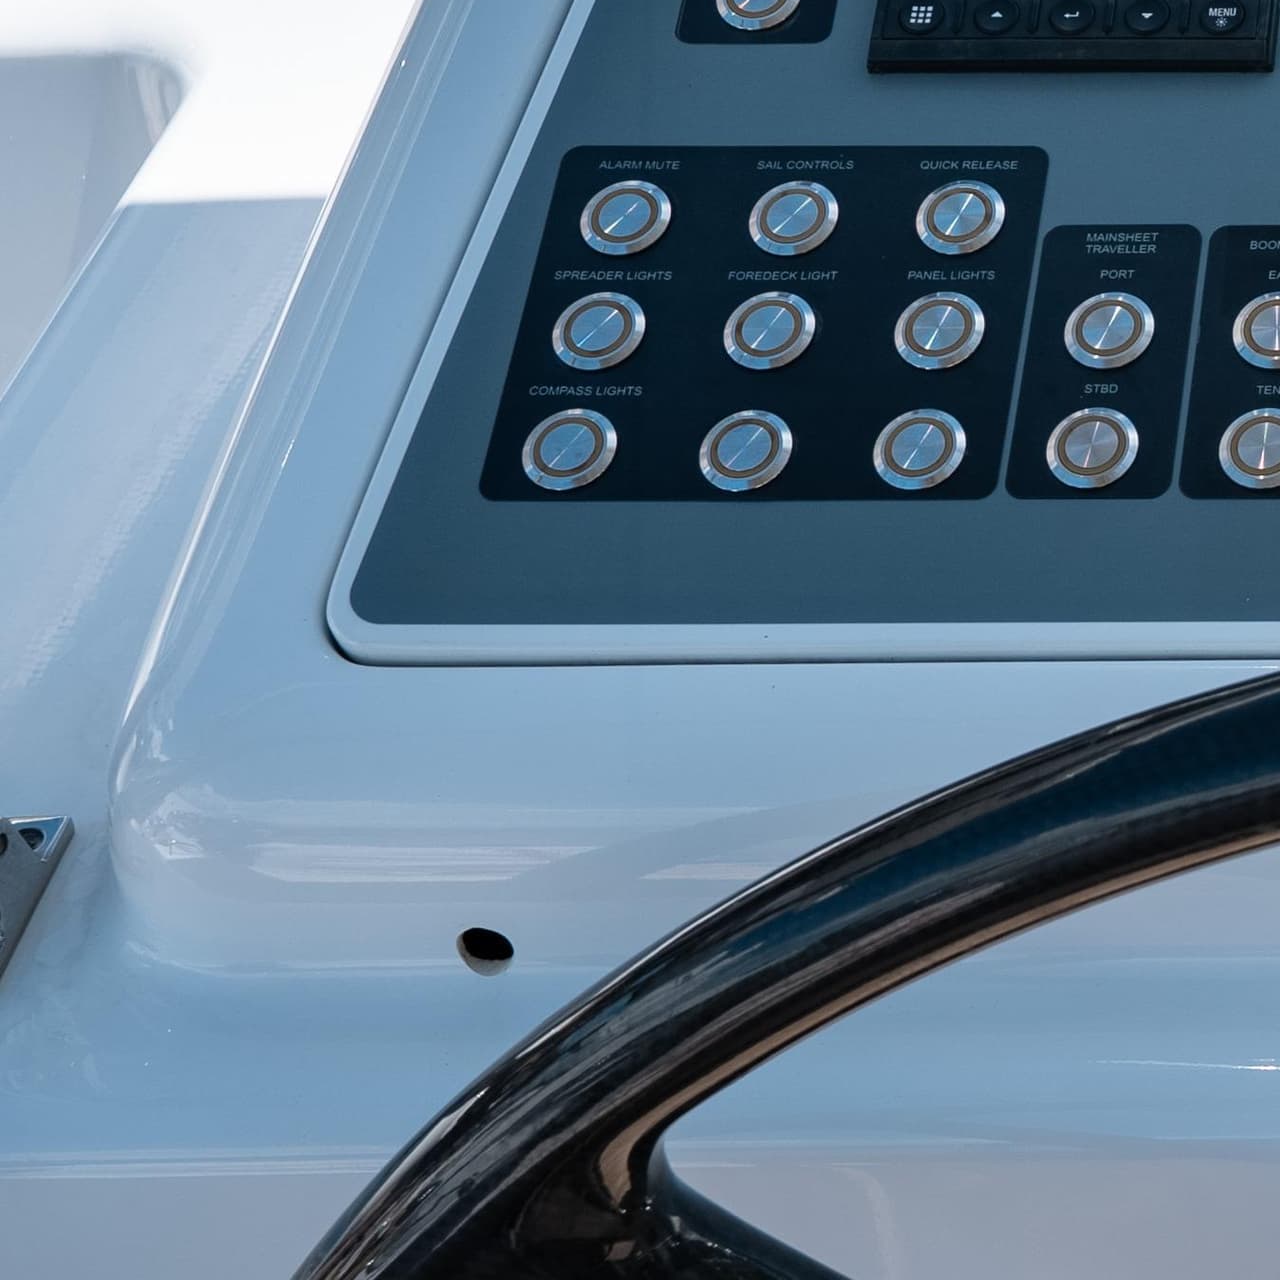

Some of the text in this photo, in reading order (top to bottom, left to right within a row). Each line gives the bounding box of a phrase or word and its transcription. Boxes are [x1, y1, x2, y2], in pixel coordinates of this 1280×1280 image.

[1208, 7, 1238, 17] MENU
[599, 160, 680, 170] ALARM MUTE
[756, 160, 854, 170] SAIL CONTROLS
[920, 160, 1018, 170] QUICK RELEASE
[1086, 232, 1159, 242] MAINSHEET
[1085, 244, 1156, 254] TRAVELLER
[554, 270, 672, 280] SPREADER LIGHTS
[728, 270, 838, 280] FOREDECK LIGHT
[906, 270, 996, 280] PANEL LIGHTS
[1100, 270, 1136, 280] PORT
[529, 386, 642, 396] COMPASS LIGHTS
[1084, 384, 1119, 394] STBD
